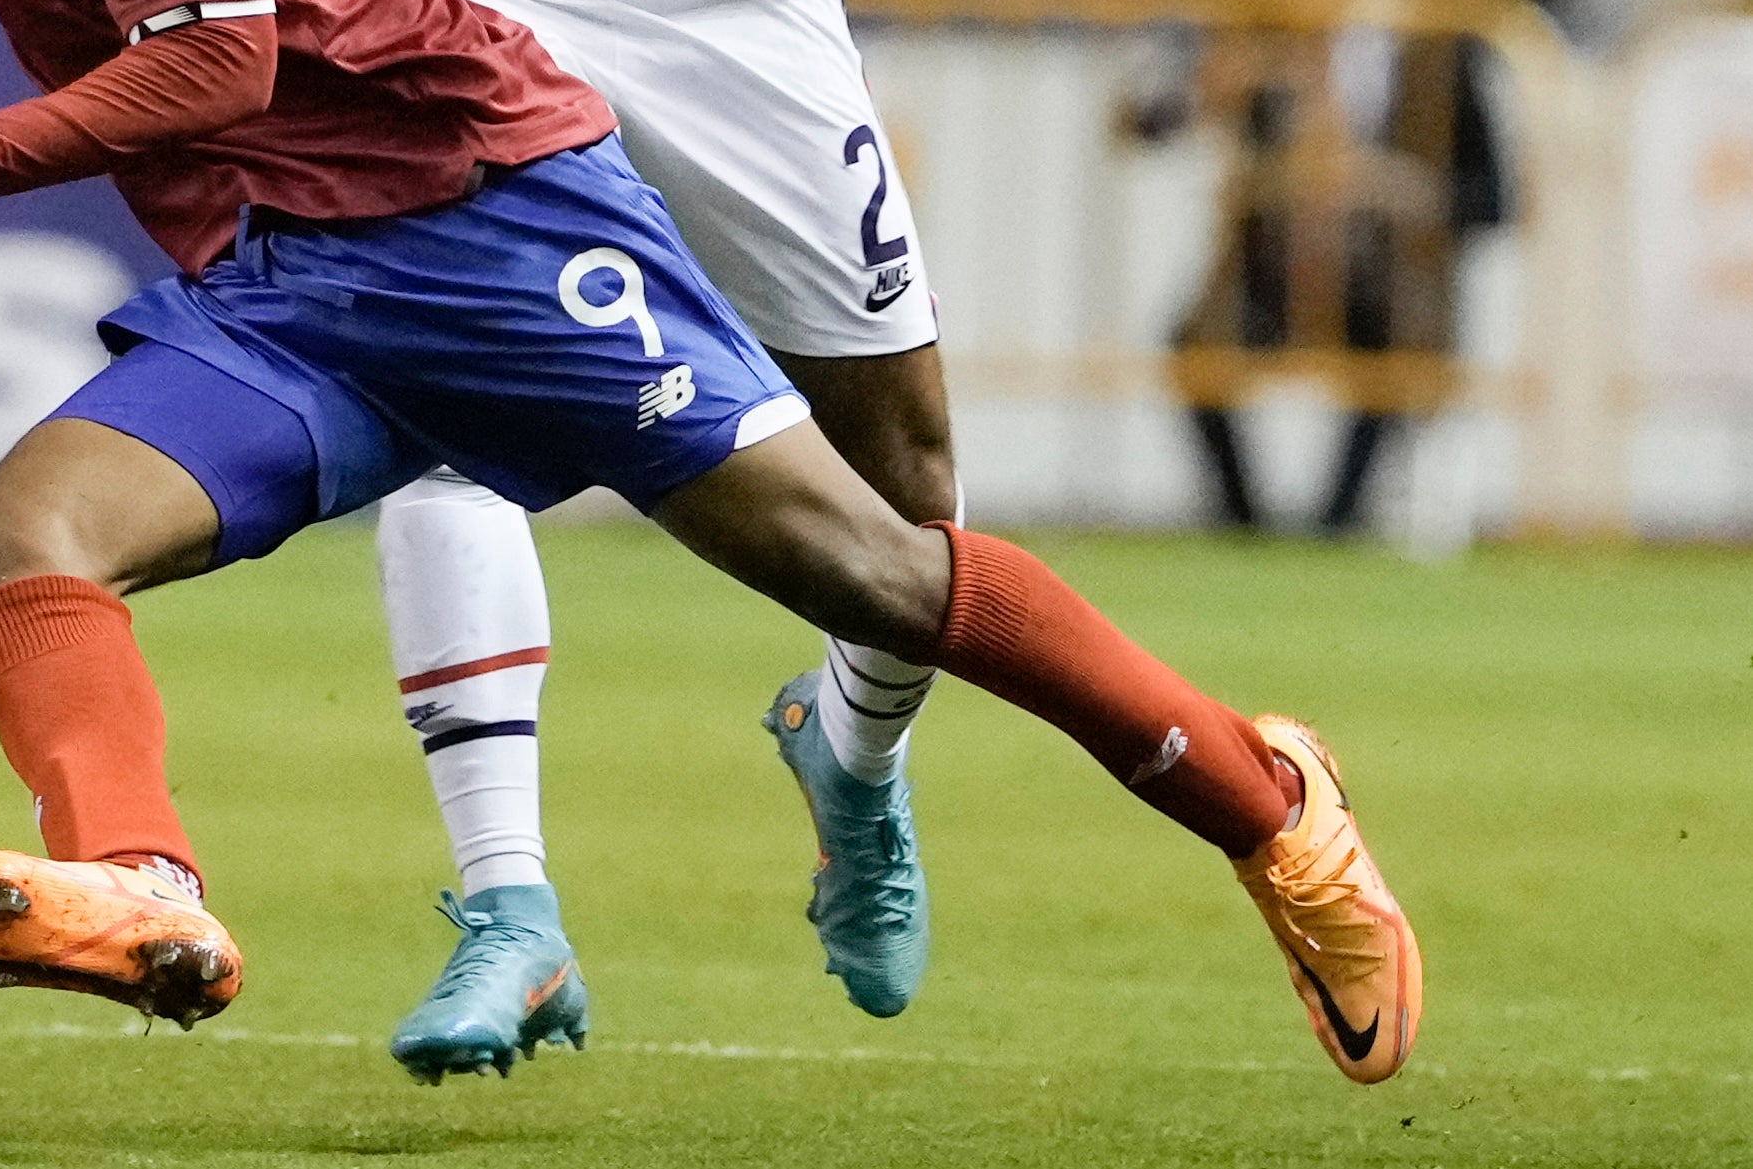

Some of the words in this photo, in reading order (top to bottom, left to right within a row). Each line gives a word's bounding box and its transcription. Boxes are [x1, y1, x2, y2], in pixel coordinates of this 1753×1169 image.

[844, 124, 908, 267] 2
[557, 246, 665, 358] 9
[873, 262, 912, 294] NIKE
